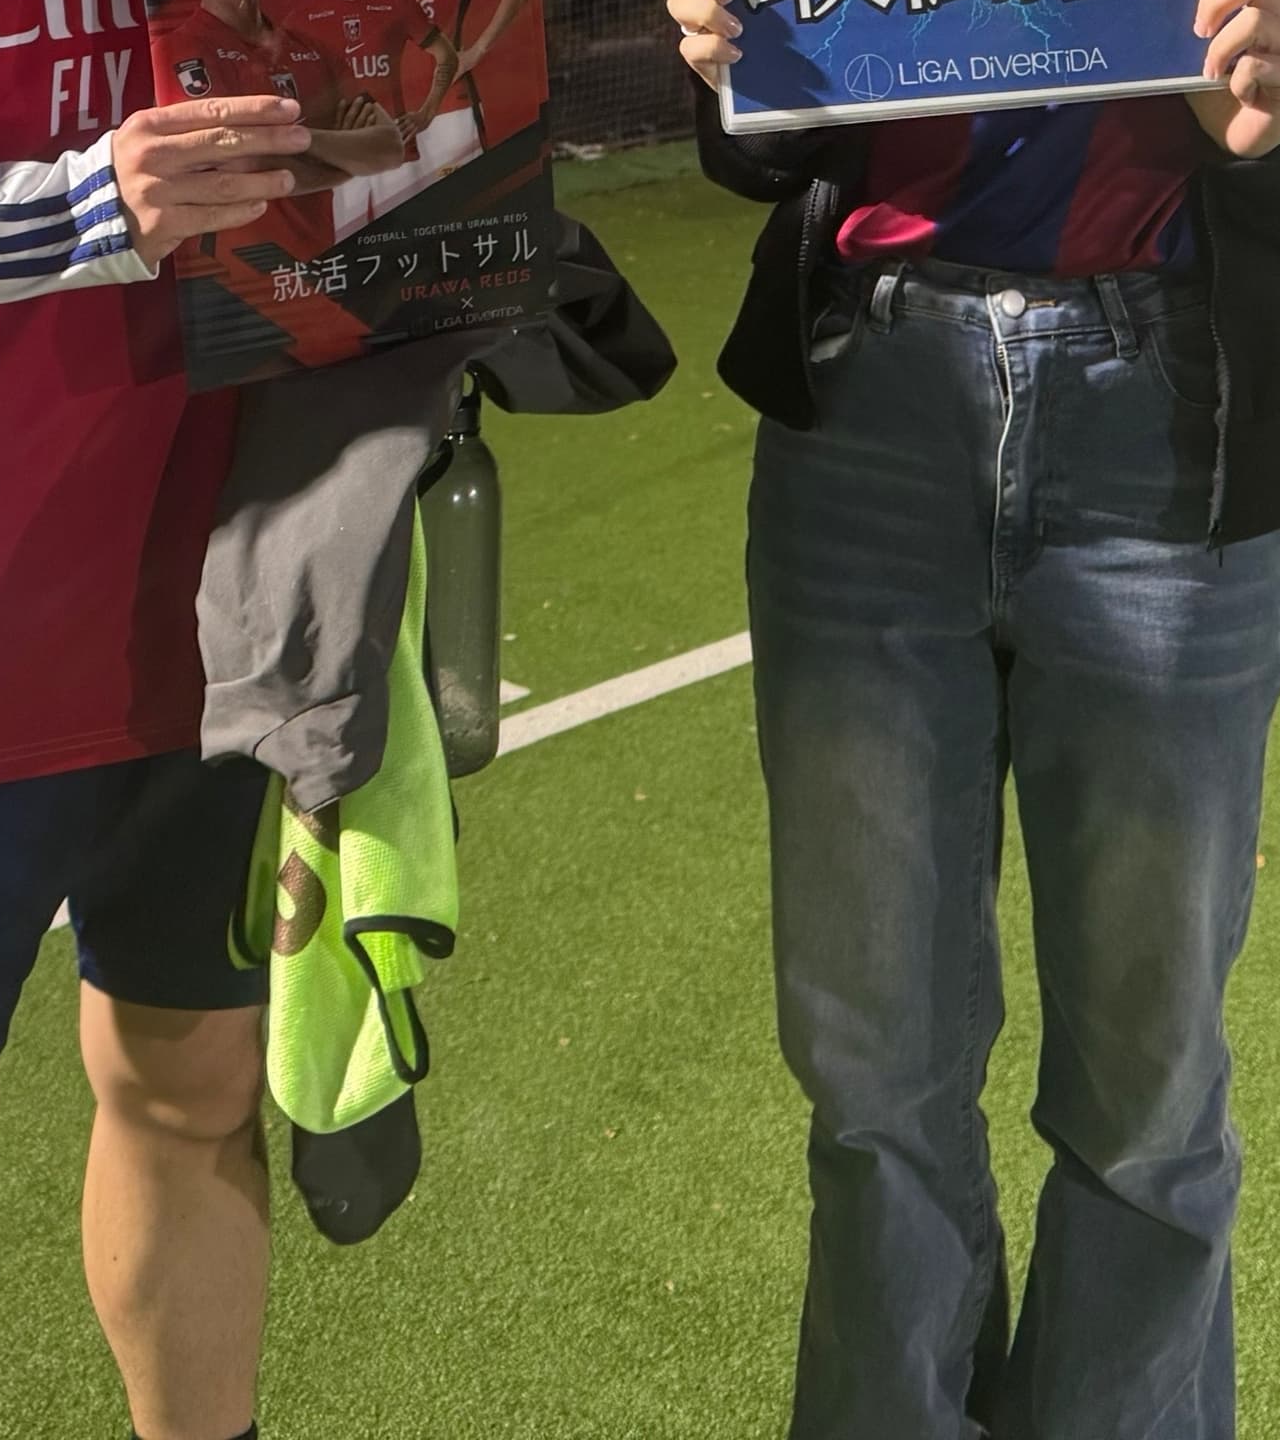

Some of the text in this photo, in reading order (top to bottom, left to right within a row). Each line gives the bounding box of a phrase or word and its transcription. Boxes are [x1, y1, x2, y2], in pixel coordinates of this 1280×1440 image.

[346, 54, 390, 79] LUS
[50, 48, 133, 137] FLY
[357, 212, 529, 247] FOOTBALL TOGETHER URAWA REDS
[270, 228, 538, 303] 就活フットサル
[400, 267, 532, 302] URAWA REDS
